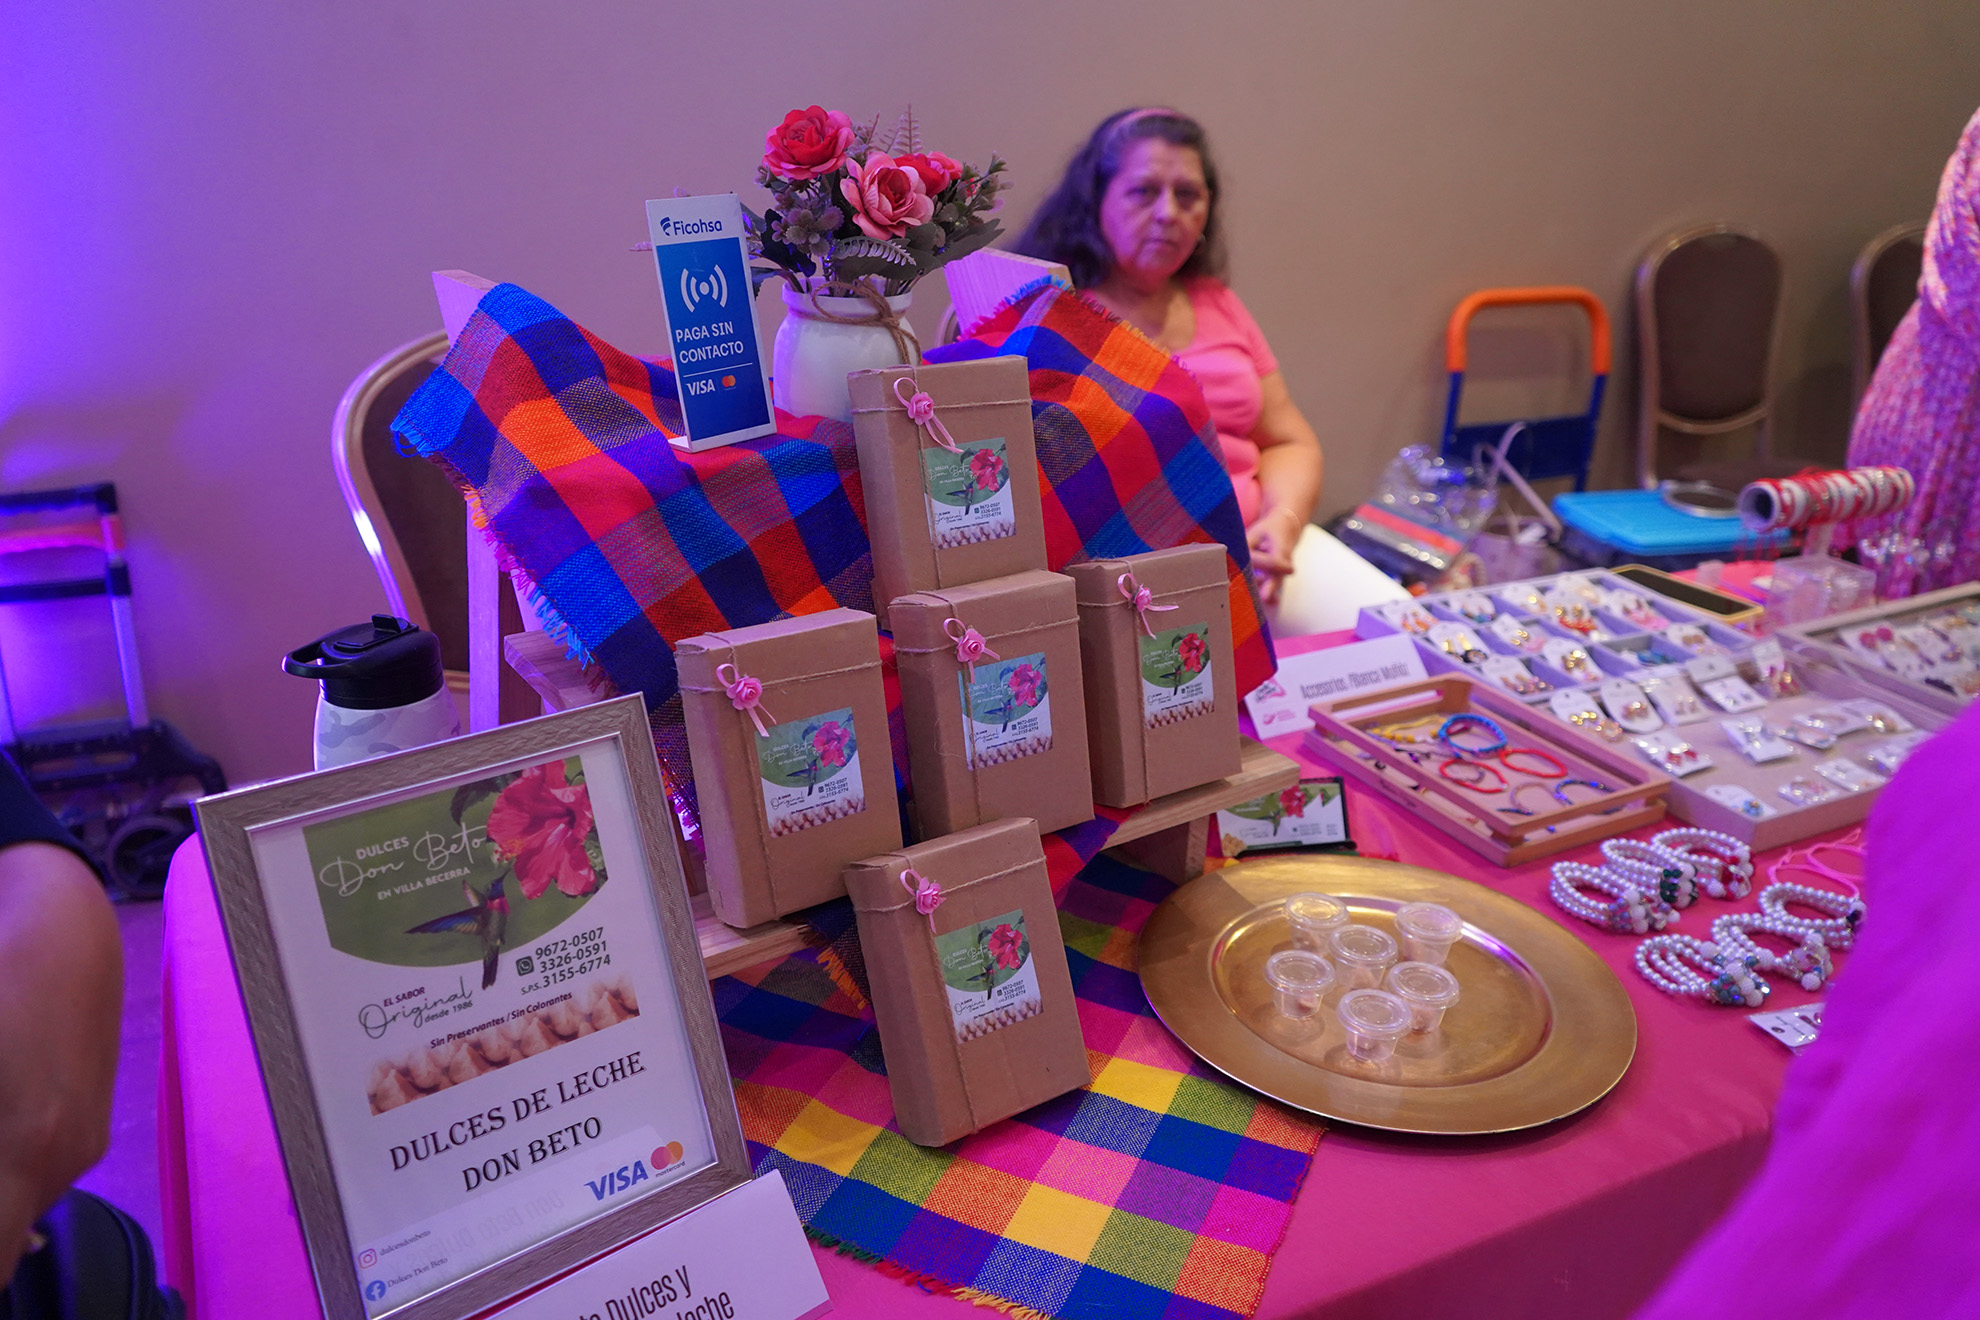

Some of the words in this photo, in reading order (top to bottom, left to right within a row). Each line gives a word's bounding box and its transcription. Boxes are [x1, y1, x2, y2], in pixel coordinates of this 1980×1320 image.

[673, 218, 722, 236] Ficohsa
[675, 325, 710, 343] PAGA
[711, 321, 734, 337] SIN
[679, 341, 744, 364] CONTACTO
[685, 379, 716, 396] VISA
[319, 856, 404, 897] Don
[412, 821, 488, 871] Beto
[356, 836, 409, 860] DULCES
[377, 888, 392, 900] EN
[394, 880, 424, 895] VILLA
[425, 866, 471, 886] BECERRA
[535, 926, 605, 960] 9672-0507
[539, 941, 608, 974] 3326-0591
[542, 954, 611, 989] 3155-6774
[358, 976, 473, 1039] Original
[383, 996, 396, 1008] EL
[398, 986, 425, 1004] SABOR
[424, 1008, 450, 1024] desde
[452, 1000, 473, 1013] 1986
[430, 1034, 445, 1049] Sin
[446, 1014, 506, 1043] Preservantes
[511, 1006, 526, 1020] Sin
[526, 990, 573, 1015] Colorantes
[389, 1106, 508, 1172] DULCES
[511, 1088, 553, 1122] DE
[556, 1051, 647, 1105] LECHE
[461, 1148, 522, 1193] DON
[527, 1116, 602, 1166] BETO
[654, 1161, 686, 1178] mastercard
[583, 1160, 649, 1202] VISA
[413, 1265, 430, 1276] Don
[430, 1257, 448, 1269] Beto
[605, 1274, 678, 1320] Dulces
[675, 1264, 691, 1299] y
[676, 1291, 734, 1320] che
